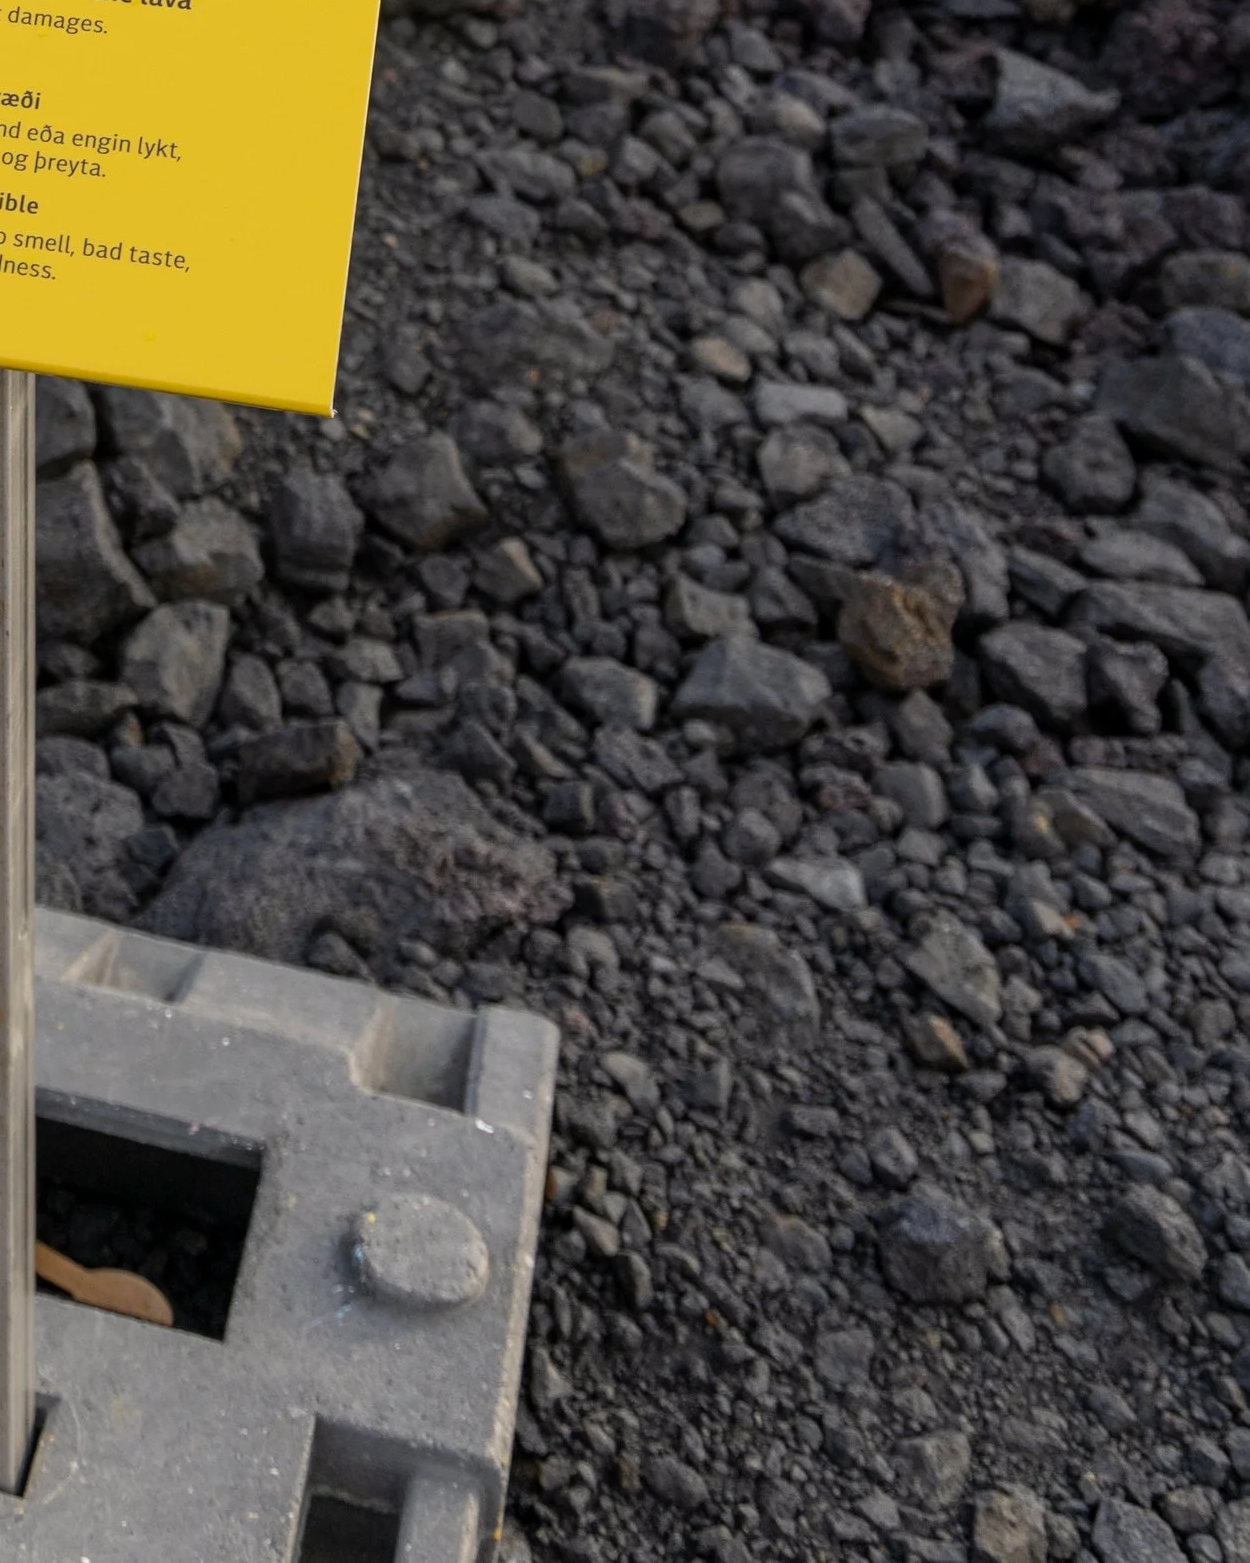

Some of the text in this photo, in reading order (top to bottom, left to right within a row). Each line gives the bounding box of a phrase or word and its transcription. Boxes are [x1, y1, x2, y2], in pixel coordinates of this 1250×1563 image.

[7, 5, 108, 35] damages.
[26, 124, 65, 145] eða
[71, 133, 131, 155] engin
[137, 136, 182, 163] lykt,
[1, 151, 29, 172] og
[33, 150, 106, 178] þreyta.
[13, 233, 75, 258] smell,
[82, 237, 123, 261] bad
[129, 246, 190, 273] taste,
